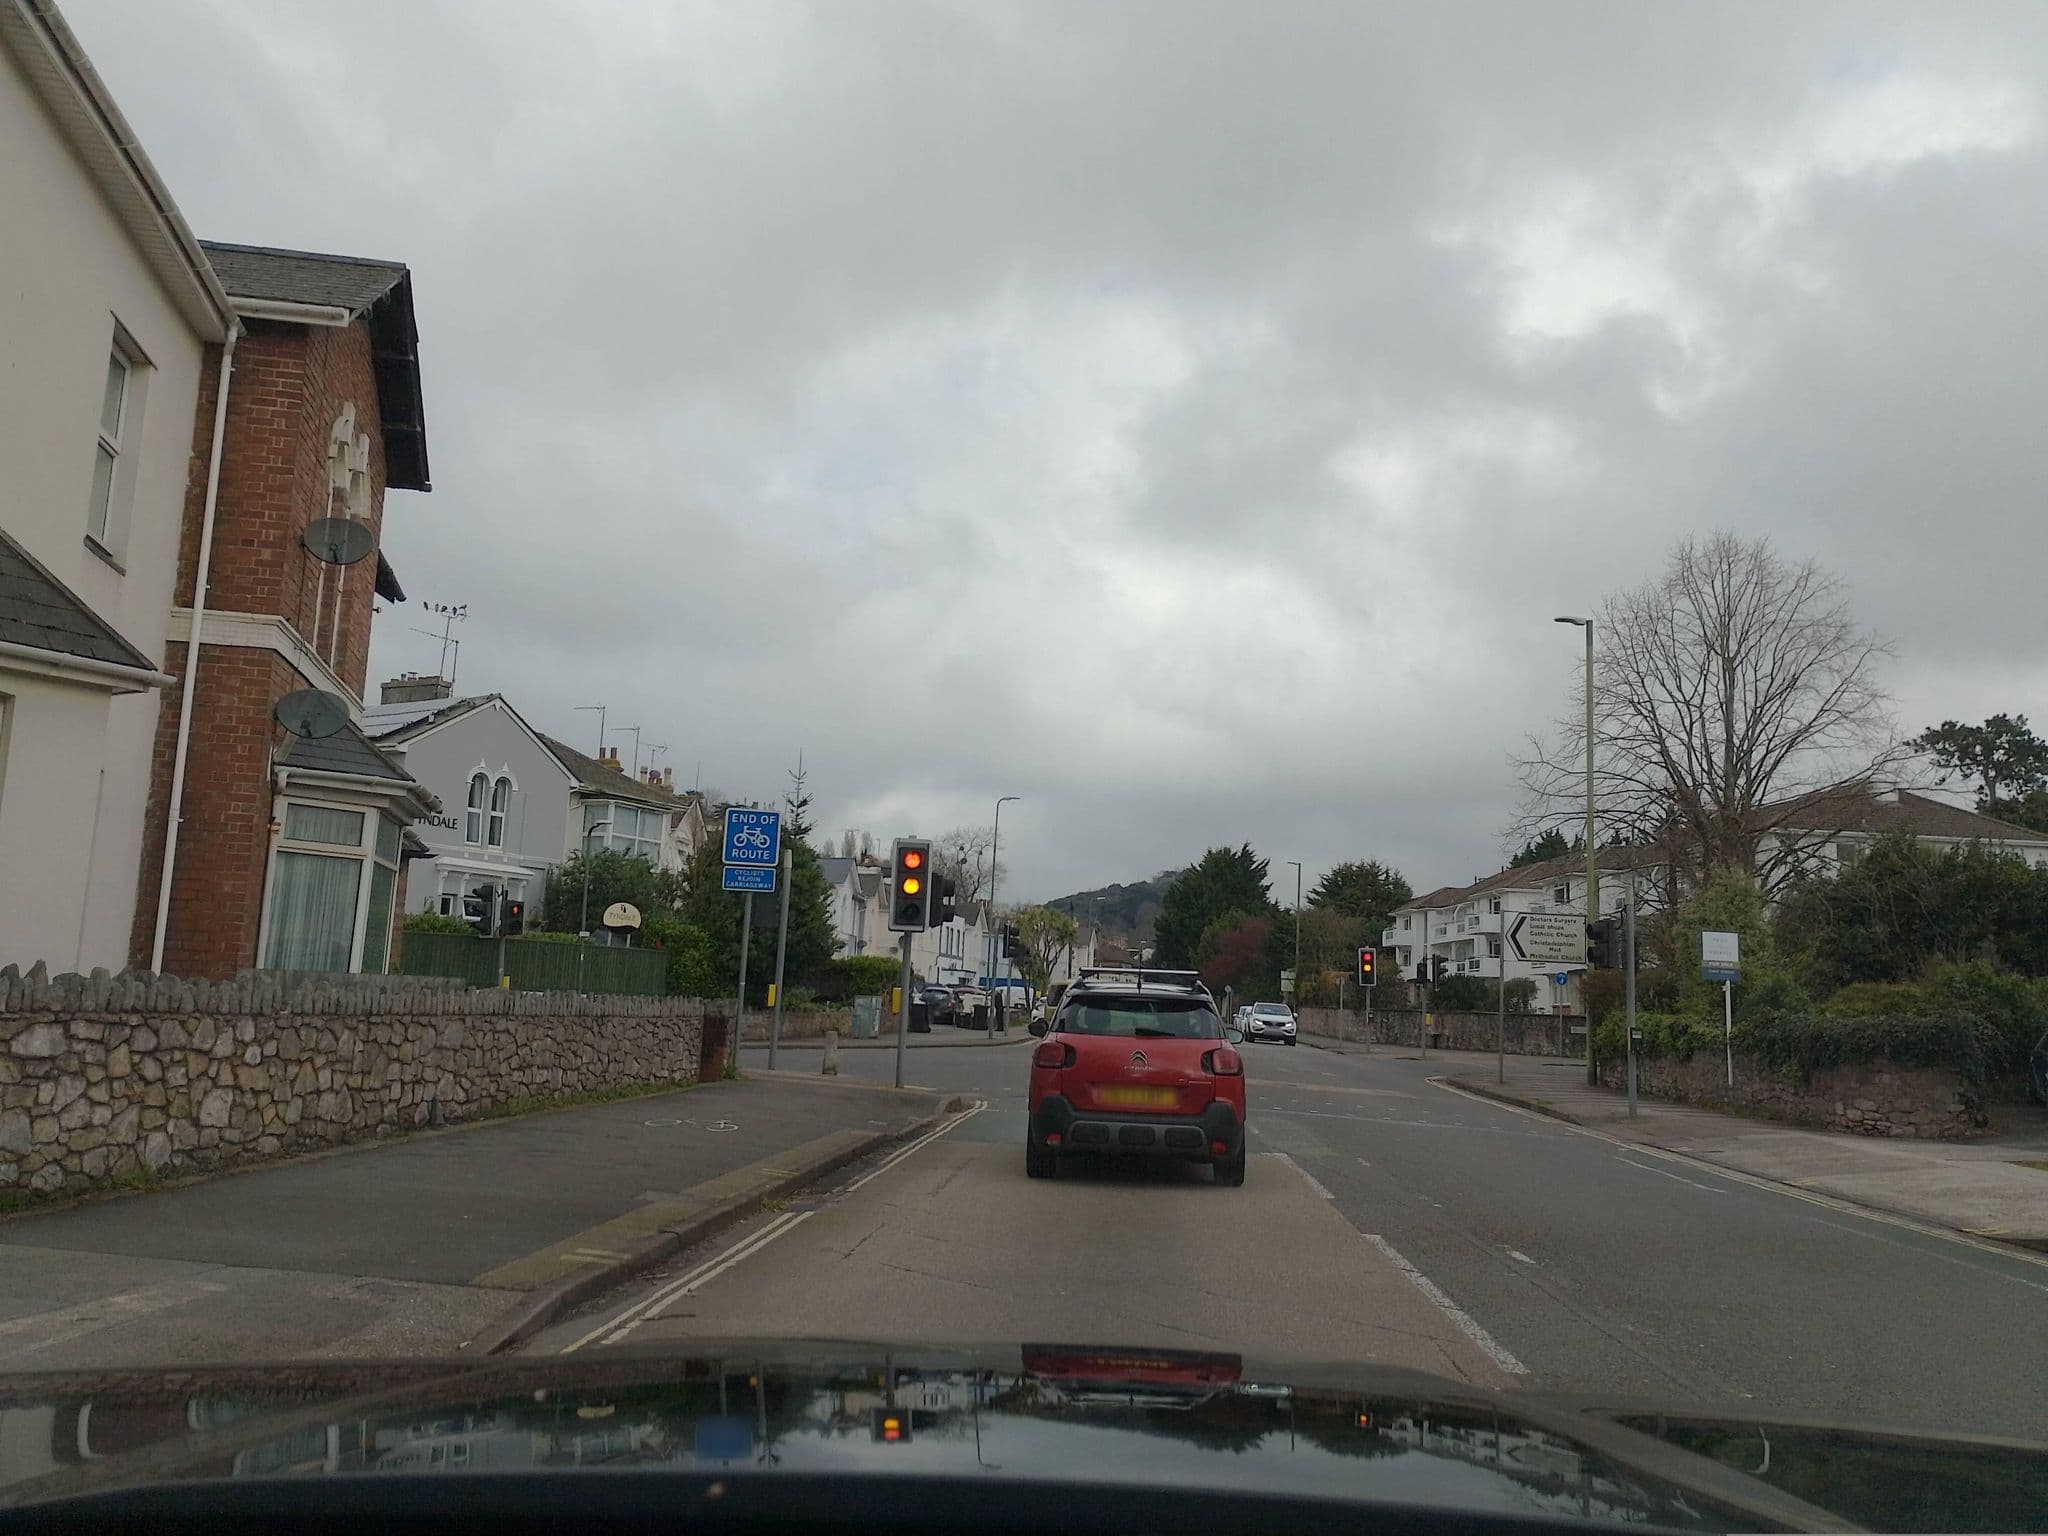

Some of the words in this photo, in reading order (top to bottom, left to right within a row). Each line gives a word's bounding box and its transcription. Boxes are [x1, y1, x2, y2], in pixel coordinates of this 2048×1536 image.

[731, 813, 757, 824] END
[760, 815, 777, 825] OF
[731, 848, 770, 860] ROUTE
[725, 881, 772, 889] CARRIAGEWAY
[1554, 917, 1577, 925] Surgery
